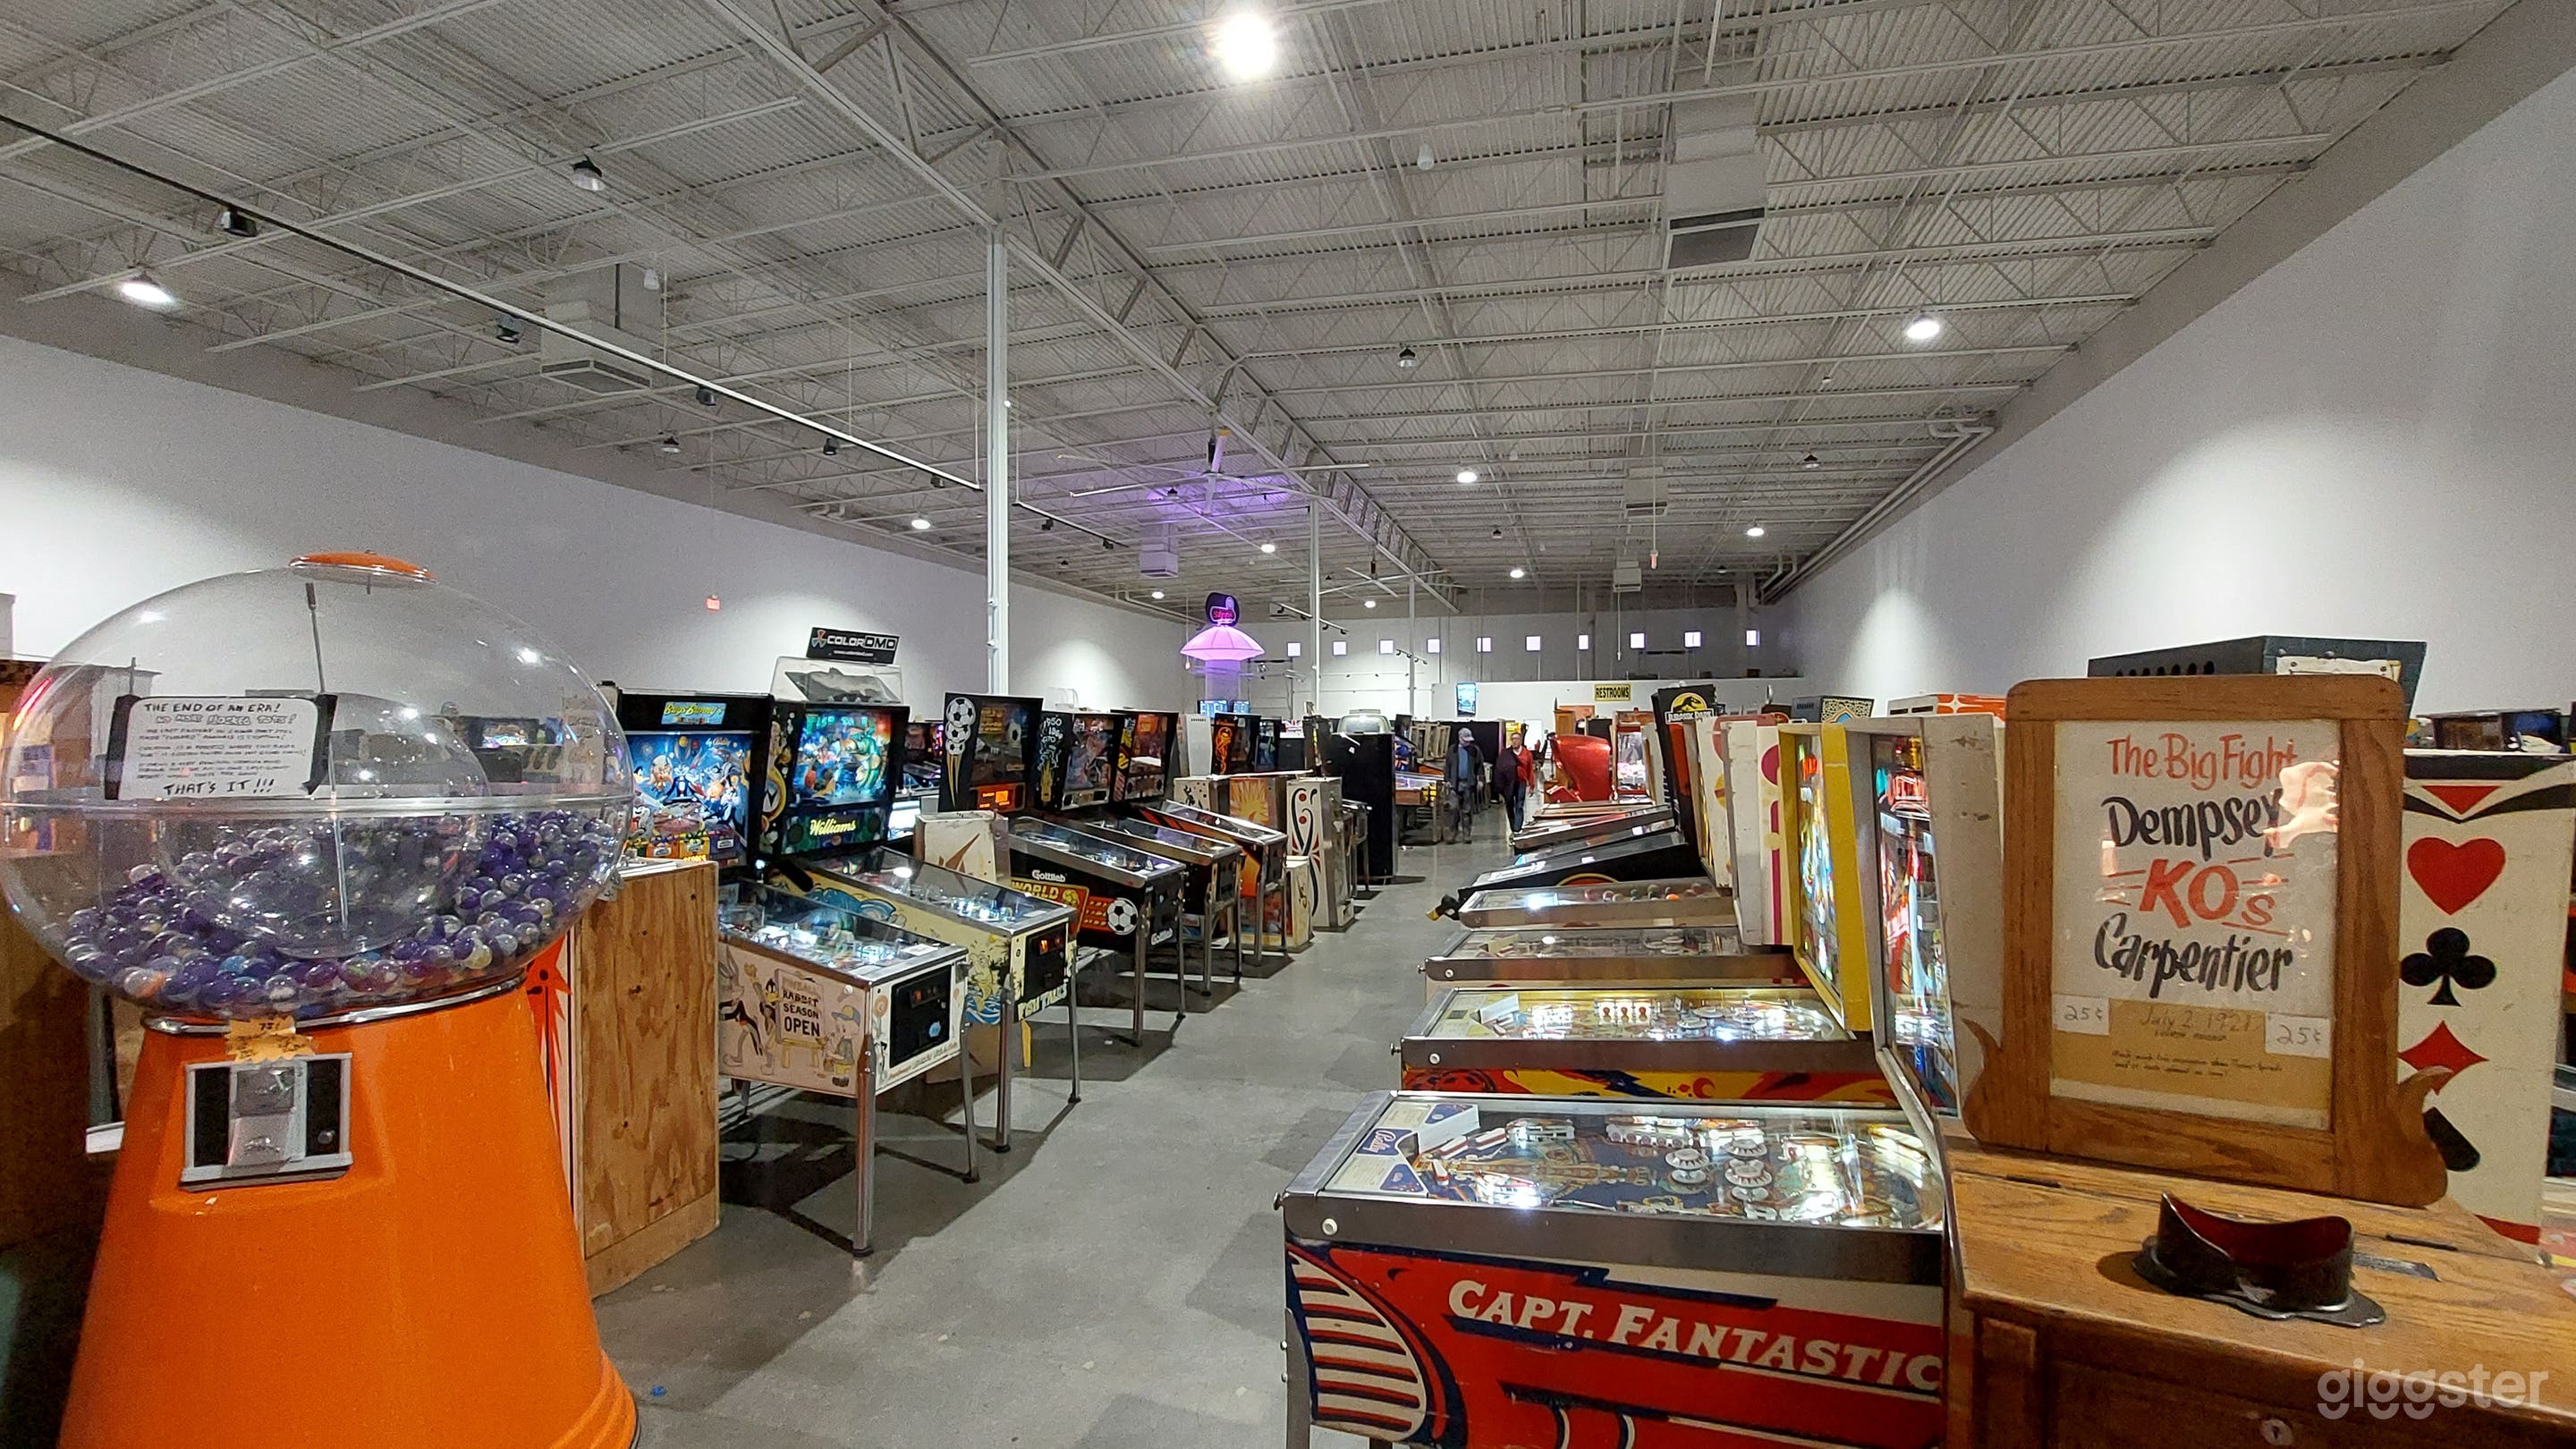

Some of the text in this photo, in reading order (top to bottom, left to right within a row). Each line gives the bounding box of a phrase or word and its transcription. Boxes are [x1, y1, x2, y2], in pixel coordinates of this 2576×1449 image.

[1595, 686, 1630, 699] RESTROOMS
[144, 702, 281, 713] THE END OF AN ERA!
[2106, 733, 2298, 791] The Big Fight
[164, 781, 216, 795] THAT'S
[809, 818, 856, 835] Williams
[2101, 788, 2284, 861] Dempsey
[1012, 880, 1059, 900] WORLD
[2094, 912, 2293, 998] Carpentier
[783, 1003, 819, 1020] SEASON
[2140, 1005, 2176, 1028] July
[784, 1015, 820, 1037] OPEN
[1448, 1279, 1942, 1391] CAPT. FANTASTIC
